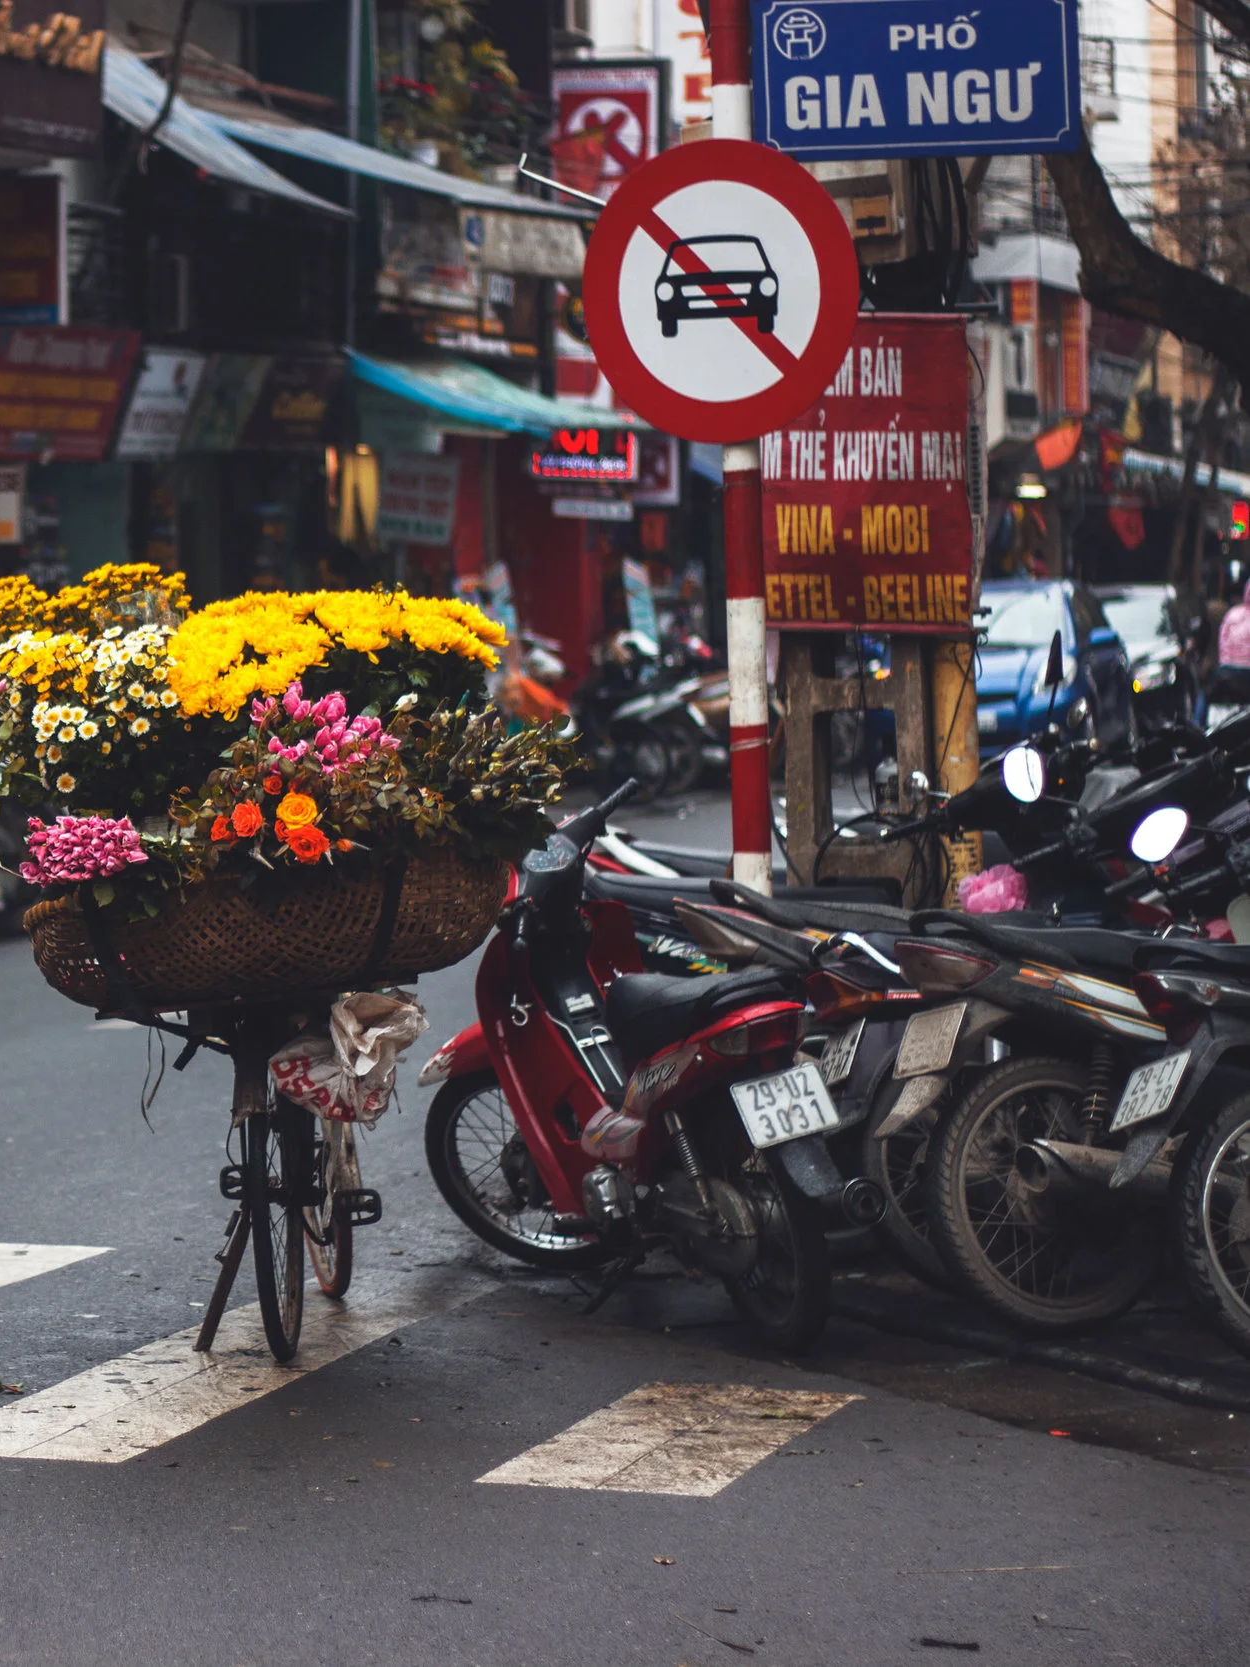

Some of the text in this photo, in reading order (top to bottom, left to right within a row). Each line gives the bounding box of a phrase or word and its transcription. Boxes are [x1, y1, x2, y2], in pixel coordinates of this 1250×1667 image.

[889, 9, 982, 51] PHỐ
[784, 61, 1042, 131] GIA NGƯ
[860, 337, 903, 397] BÁN
[790, 410, 826, 481] THẺ
[834, 413, 914, 481] KHUYẾN
[922, 431, 963, 493] MẠI
[776, 505, 835, 555] VINA
[862, 505, 930, 555] MOBI
[864, 574, 968, 622] BEELINE
[636, 1063, 677, 1097] Wave
[747, 1071, 816, 1112] 29-U2
[1131, 1057, 1179, 1097] 29-C1
[759, 1099, 827, 1140] 3031
